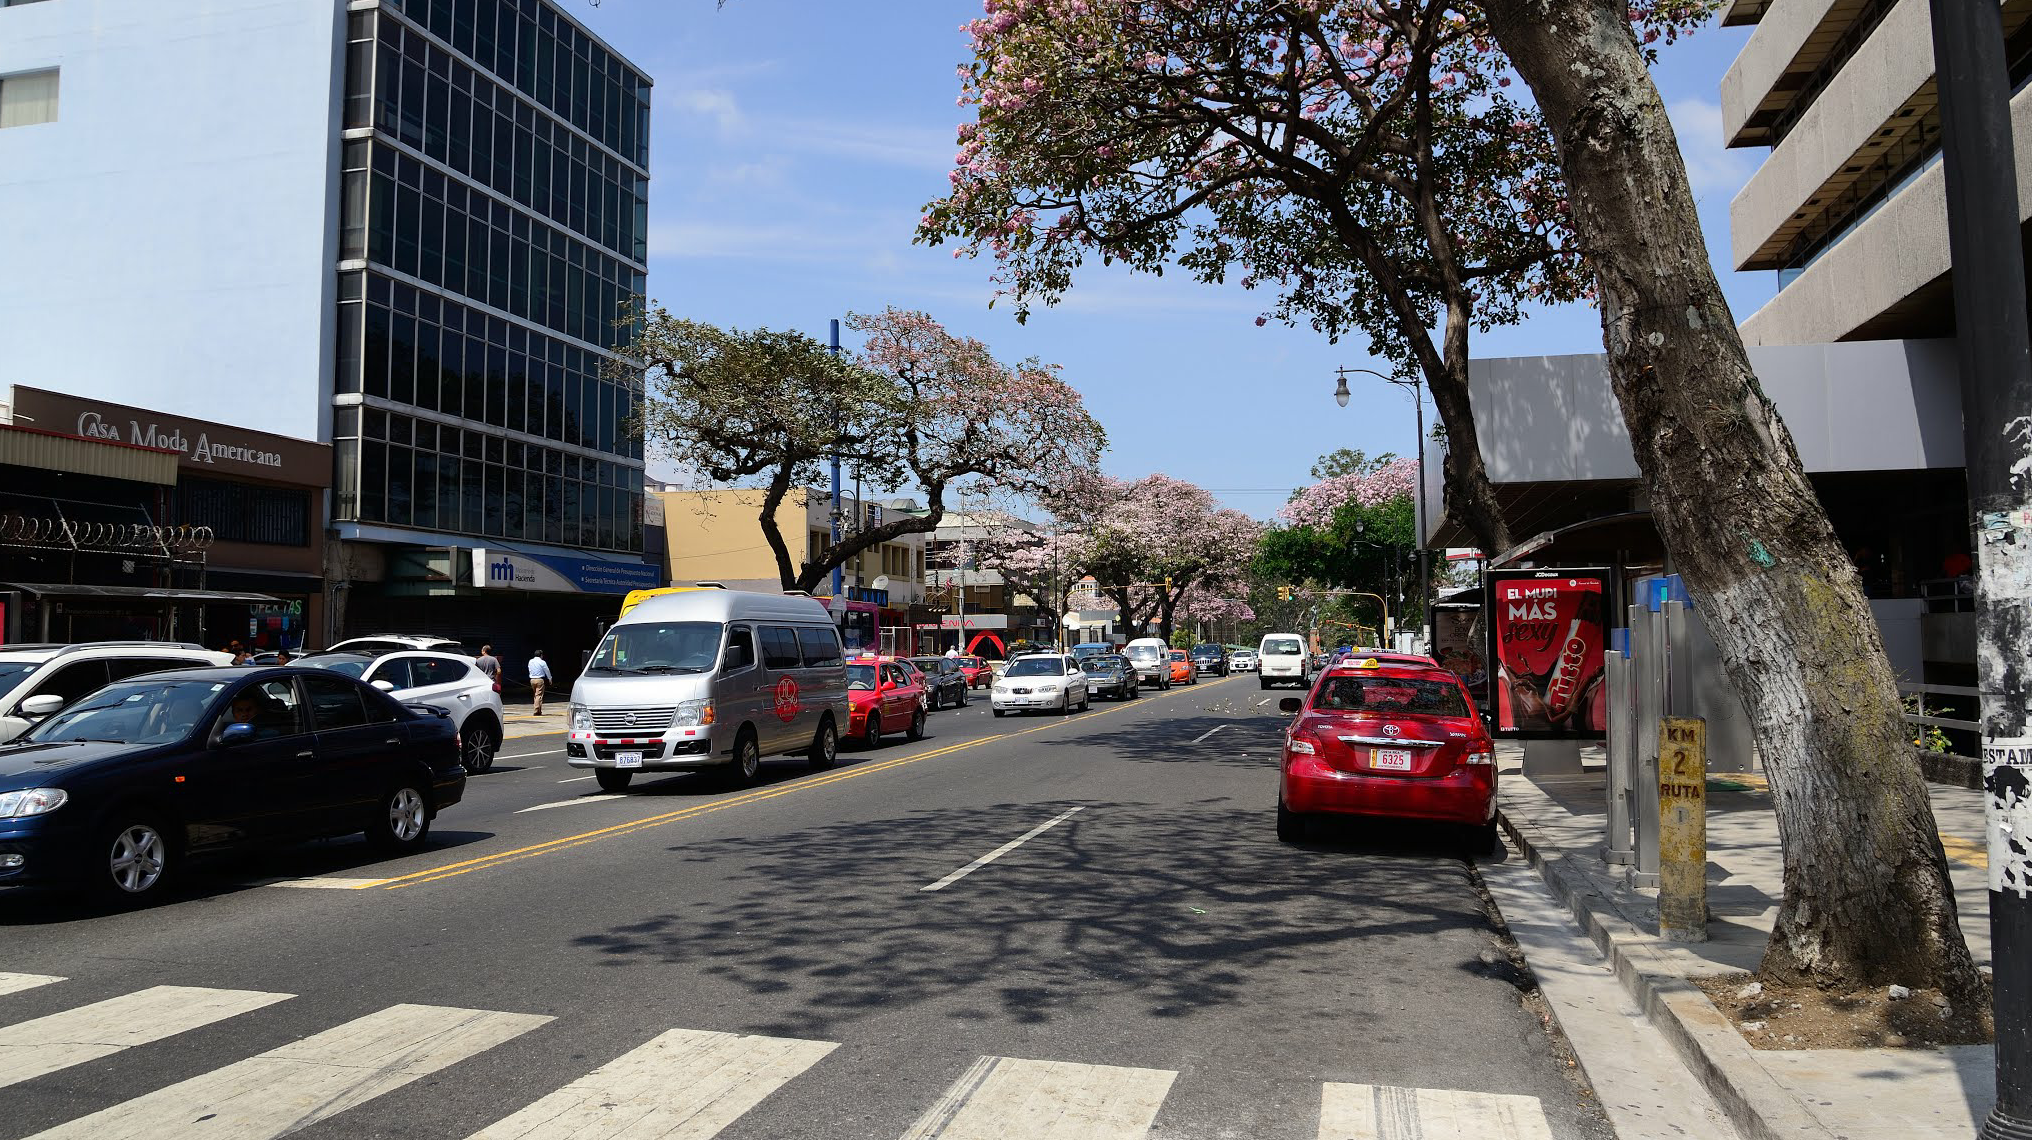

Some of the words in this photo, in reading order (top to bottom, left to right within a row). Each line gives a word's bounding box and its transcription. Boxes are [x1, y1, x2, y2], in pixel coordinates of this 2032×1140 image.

[129, 420, 189, 452] Moda
[191, 432, 282, 467] Americana
[515, 574, 535, 583] Hacienda
[1507, 588, 1522, 600] EL
[1525, 587, 1558, 599] MUPI
[1508, 599, 1558, 621] MÁS
[1502, 621, 1559, 652] sexy
[1667, 728, 1695, 742] KM
[1382, 754, 1404, 765] 6325
[1673, 750, 1686, 776] 2
[1660, 783, 1701, 799] RUTA
